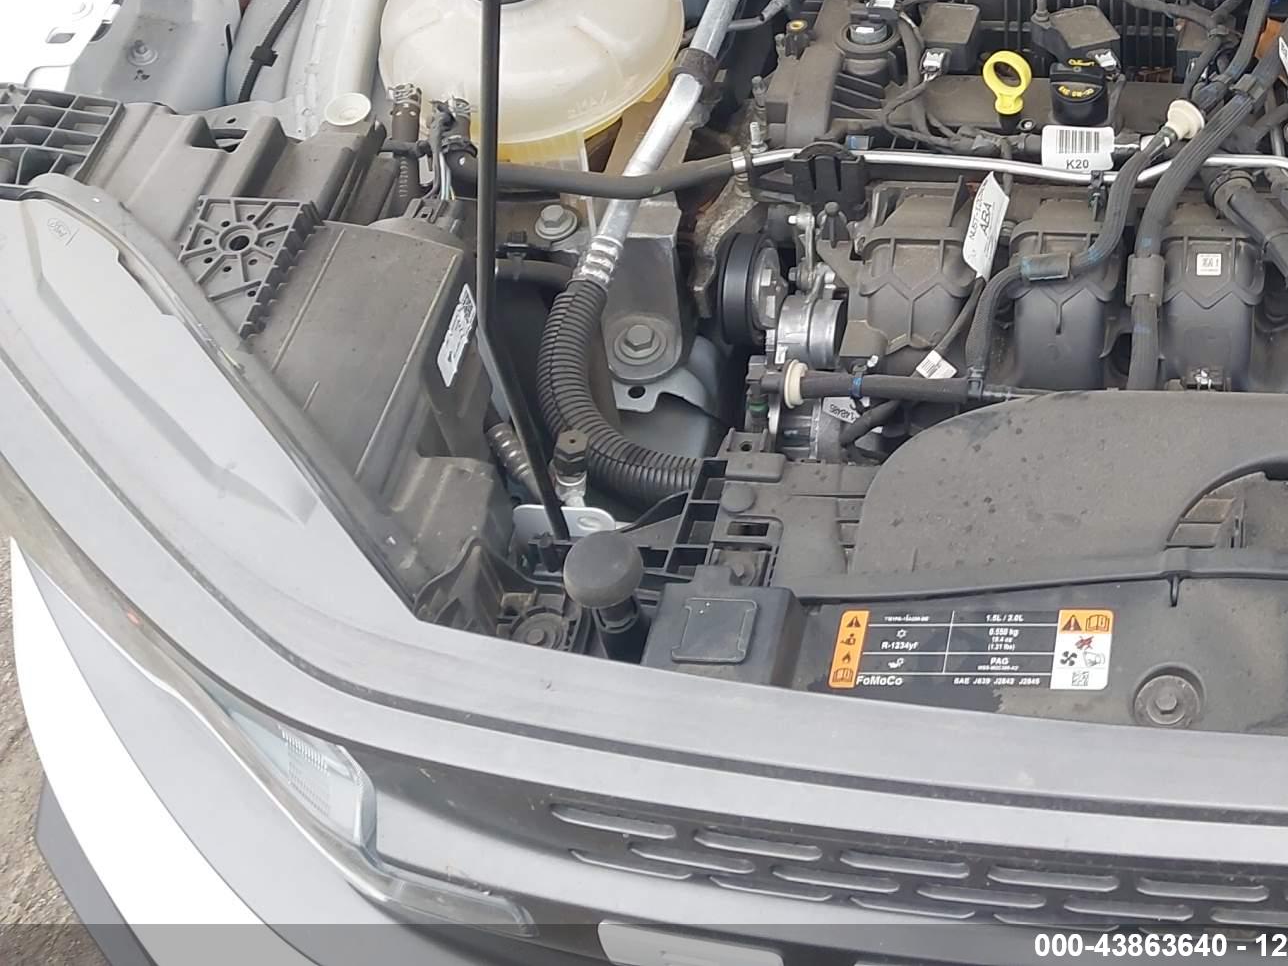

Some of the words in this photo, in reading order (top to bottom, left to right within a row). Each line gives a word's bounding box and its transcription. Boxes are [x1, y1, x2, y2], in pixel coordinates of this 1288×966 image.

[1066, 159, 1089, 170] K20
[881, 641, 919, 651] R-1234yf
[990, 657, 1009, 665] PAG
[856, 675, 904, 686] FoMoCo
